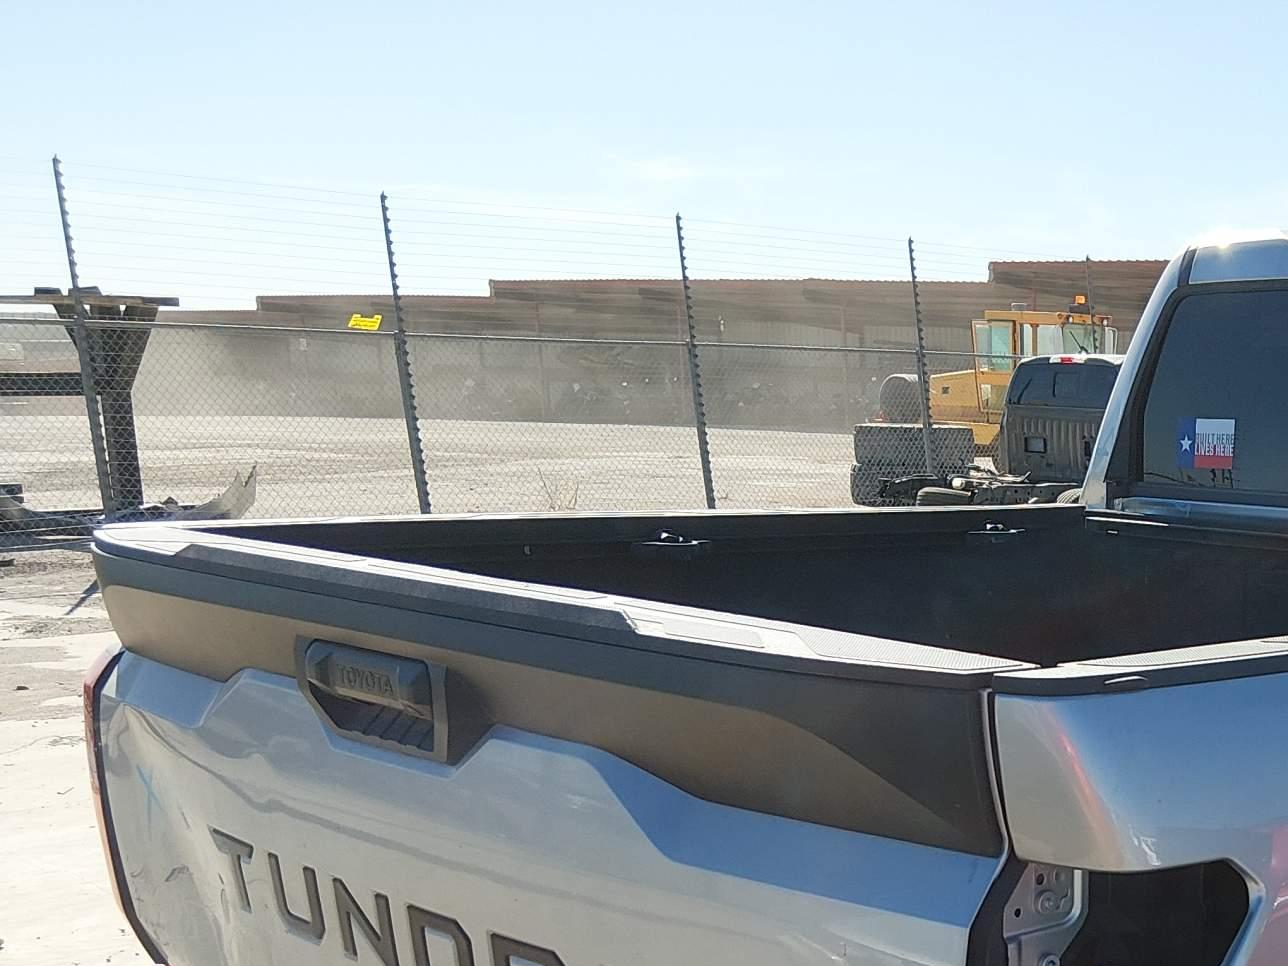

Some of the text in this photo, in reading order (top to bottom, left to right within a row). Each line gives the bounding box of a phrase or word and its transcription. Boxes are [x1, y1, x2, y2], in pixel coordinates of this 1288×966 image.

[1216, 433, 1235, 445] HERE
[1194, 444, 1234, 457] LIVES HERE
[336, 664, 394, 697] TOYOTA
